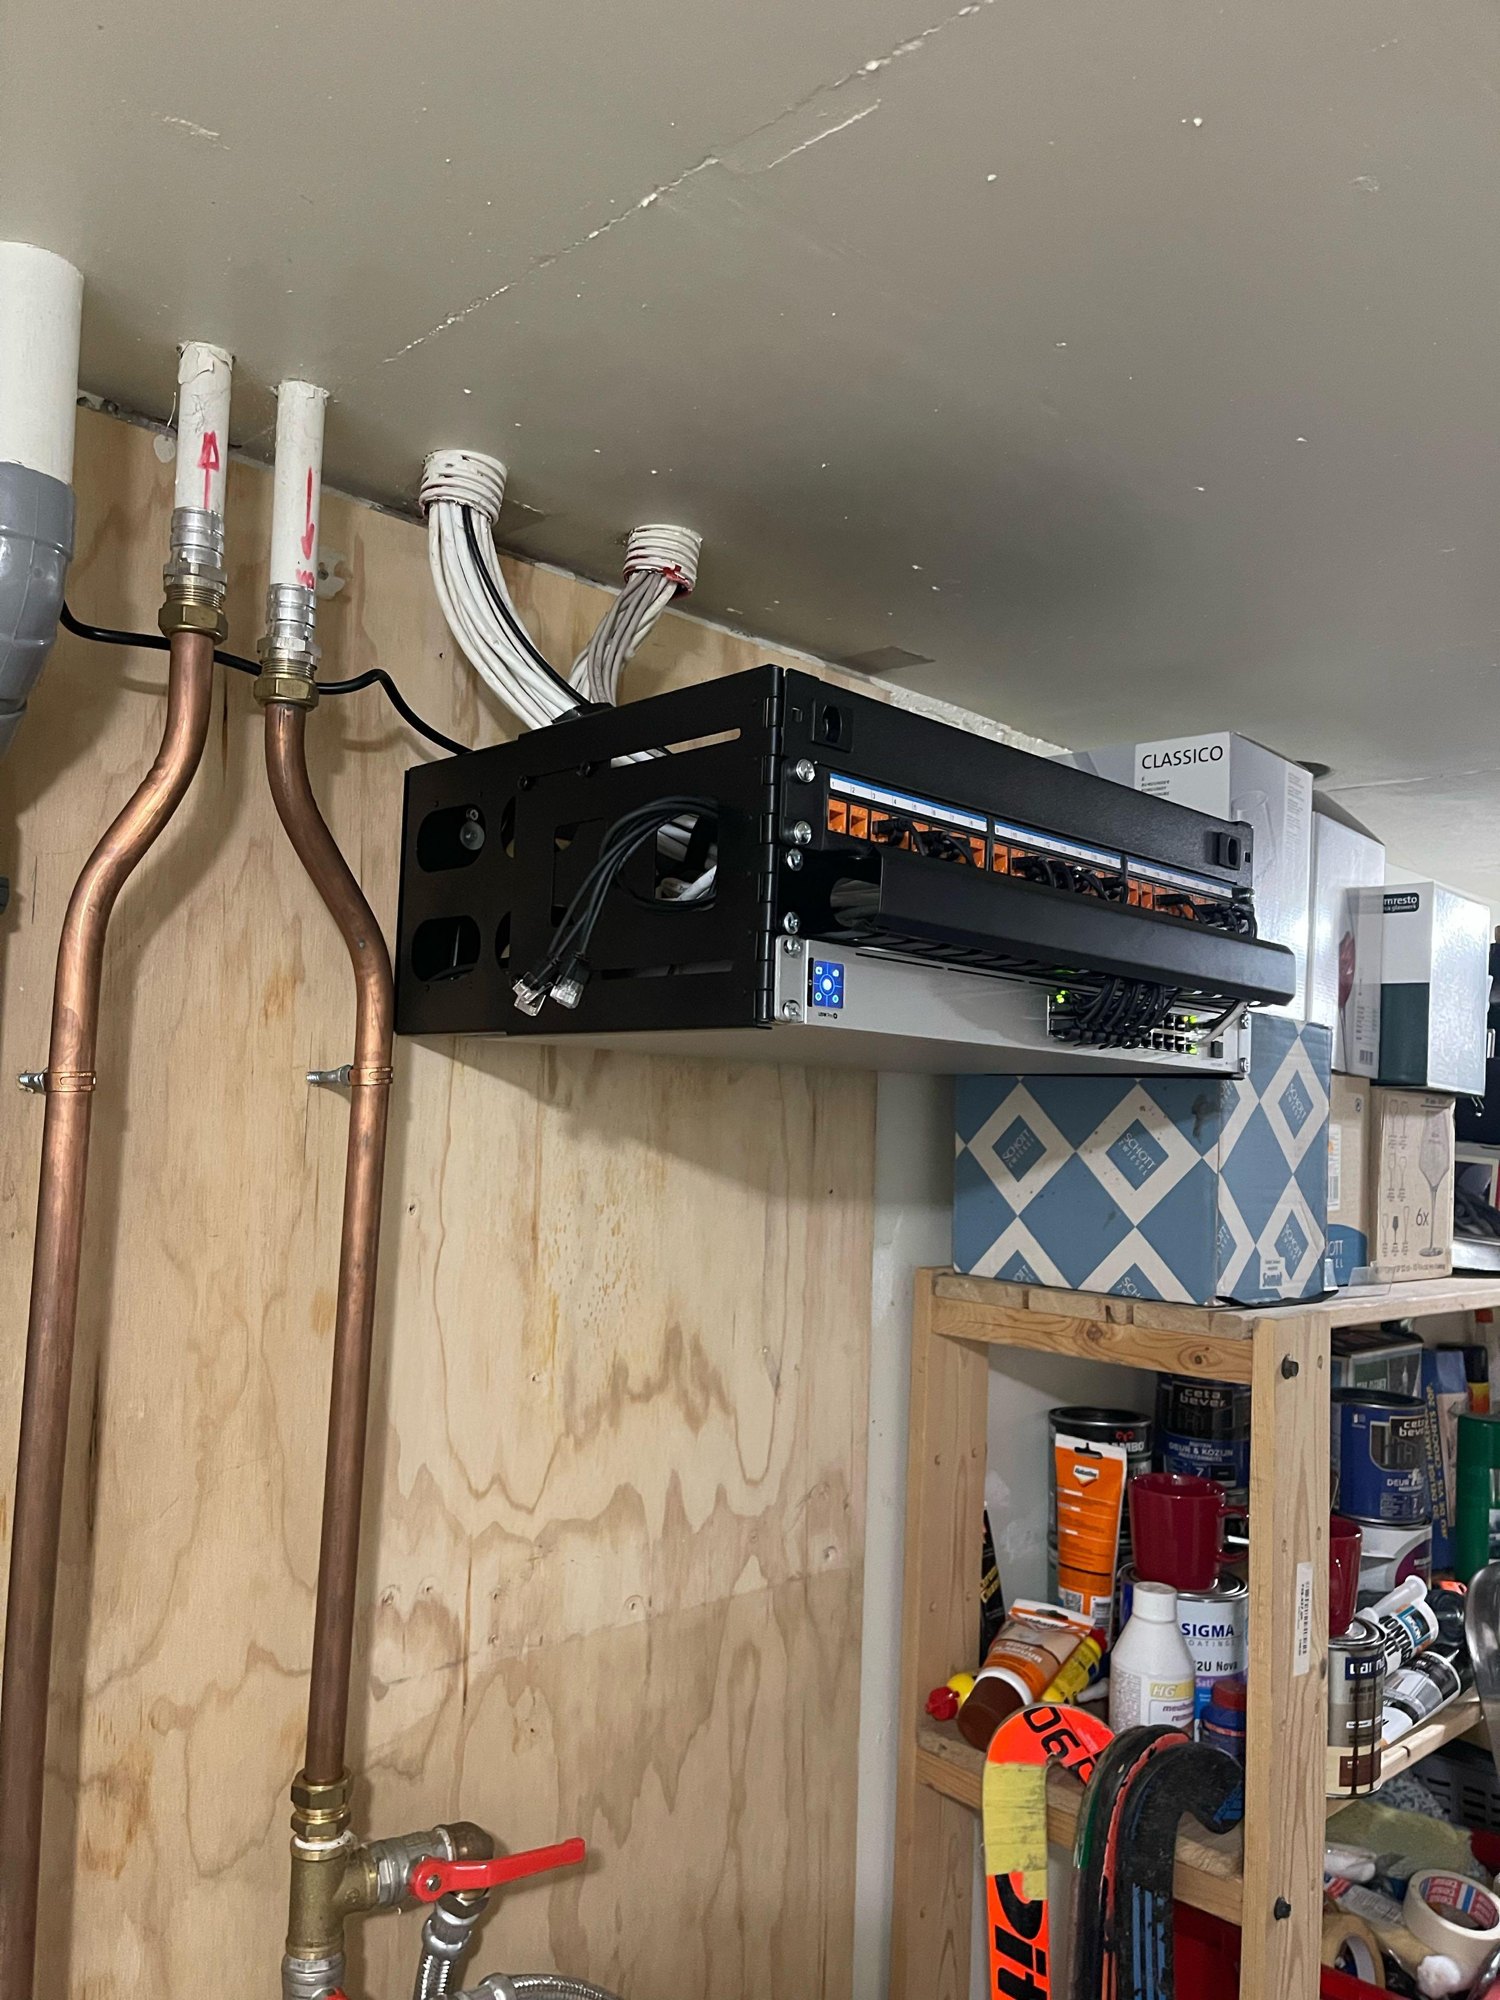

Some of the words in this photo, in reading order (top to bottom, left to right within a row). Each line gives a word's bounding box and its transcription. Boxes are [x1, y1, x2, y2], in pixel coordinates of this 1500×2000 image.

[1141, 745, 1224, 769] CLASSICO
[1002, 1129, 1030, 1159] SCHOTT
[1124, 1132, 1156, 1169] SCHOTT
[1180, 1392, 1226, 1408] bever
[1185, 1389, 1221, 1399] ceta
[1181, 1623, 1235, 1638] SIGMA
[1404, 1614, 1421, 1640] BISON
[1188, 1639, 1235, 1647] OATINGS
[1194, 1660, 1212, 1672] 2U
[1152, 1685, 1176, 1698] HG
